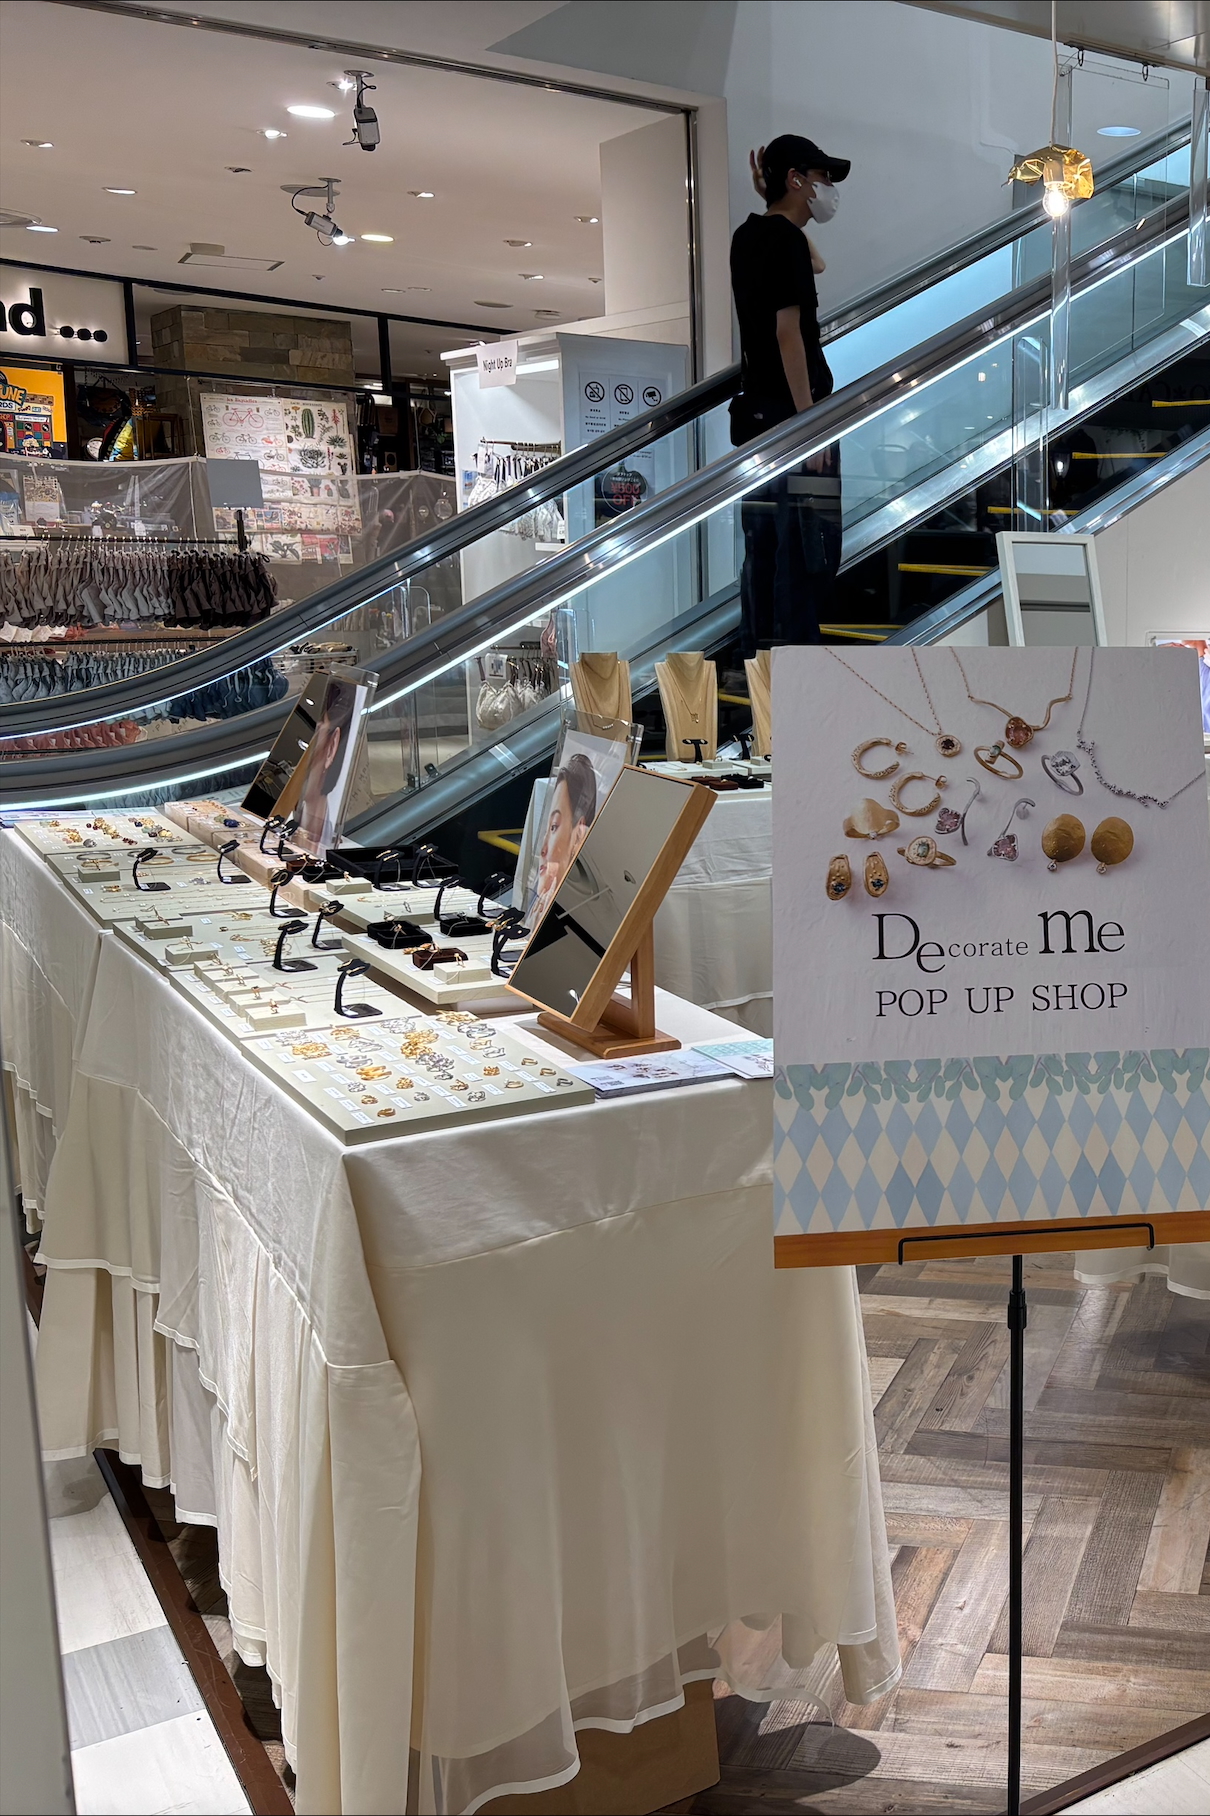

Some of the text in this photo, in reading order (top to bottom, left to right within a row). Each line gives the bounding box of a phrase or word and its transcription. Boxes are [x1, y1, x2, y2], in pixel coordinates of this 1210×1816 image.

[872, 913, 1029, 973] Decorate
[875, 982, 1128, 1017] POP UP SHOP
